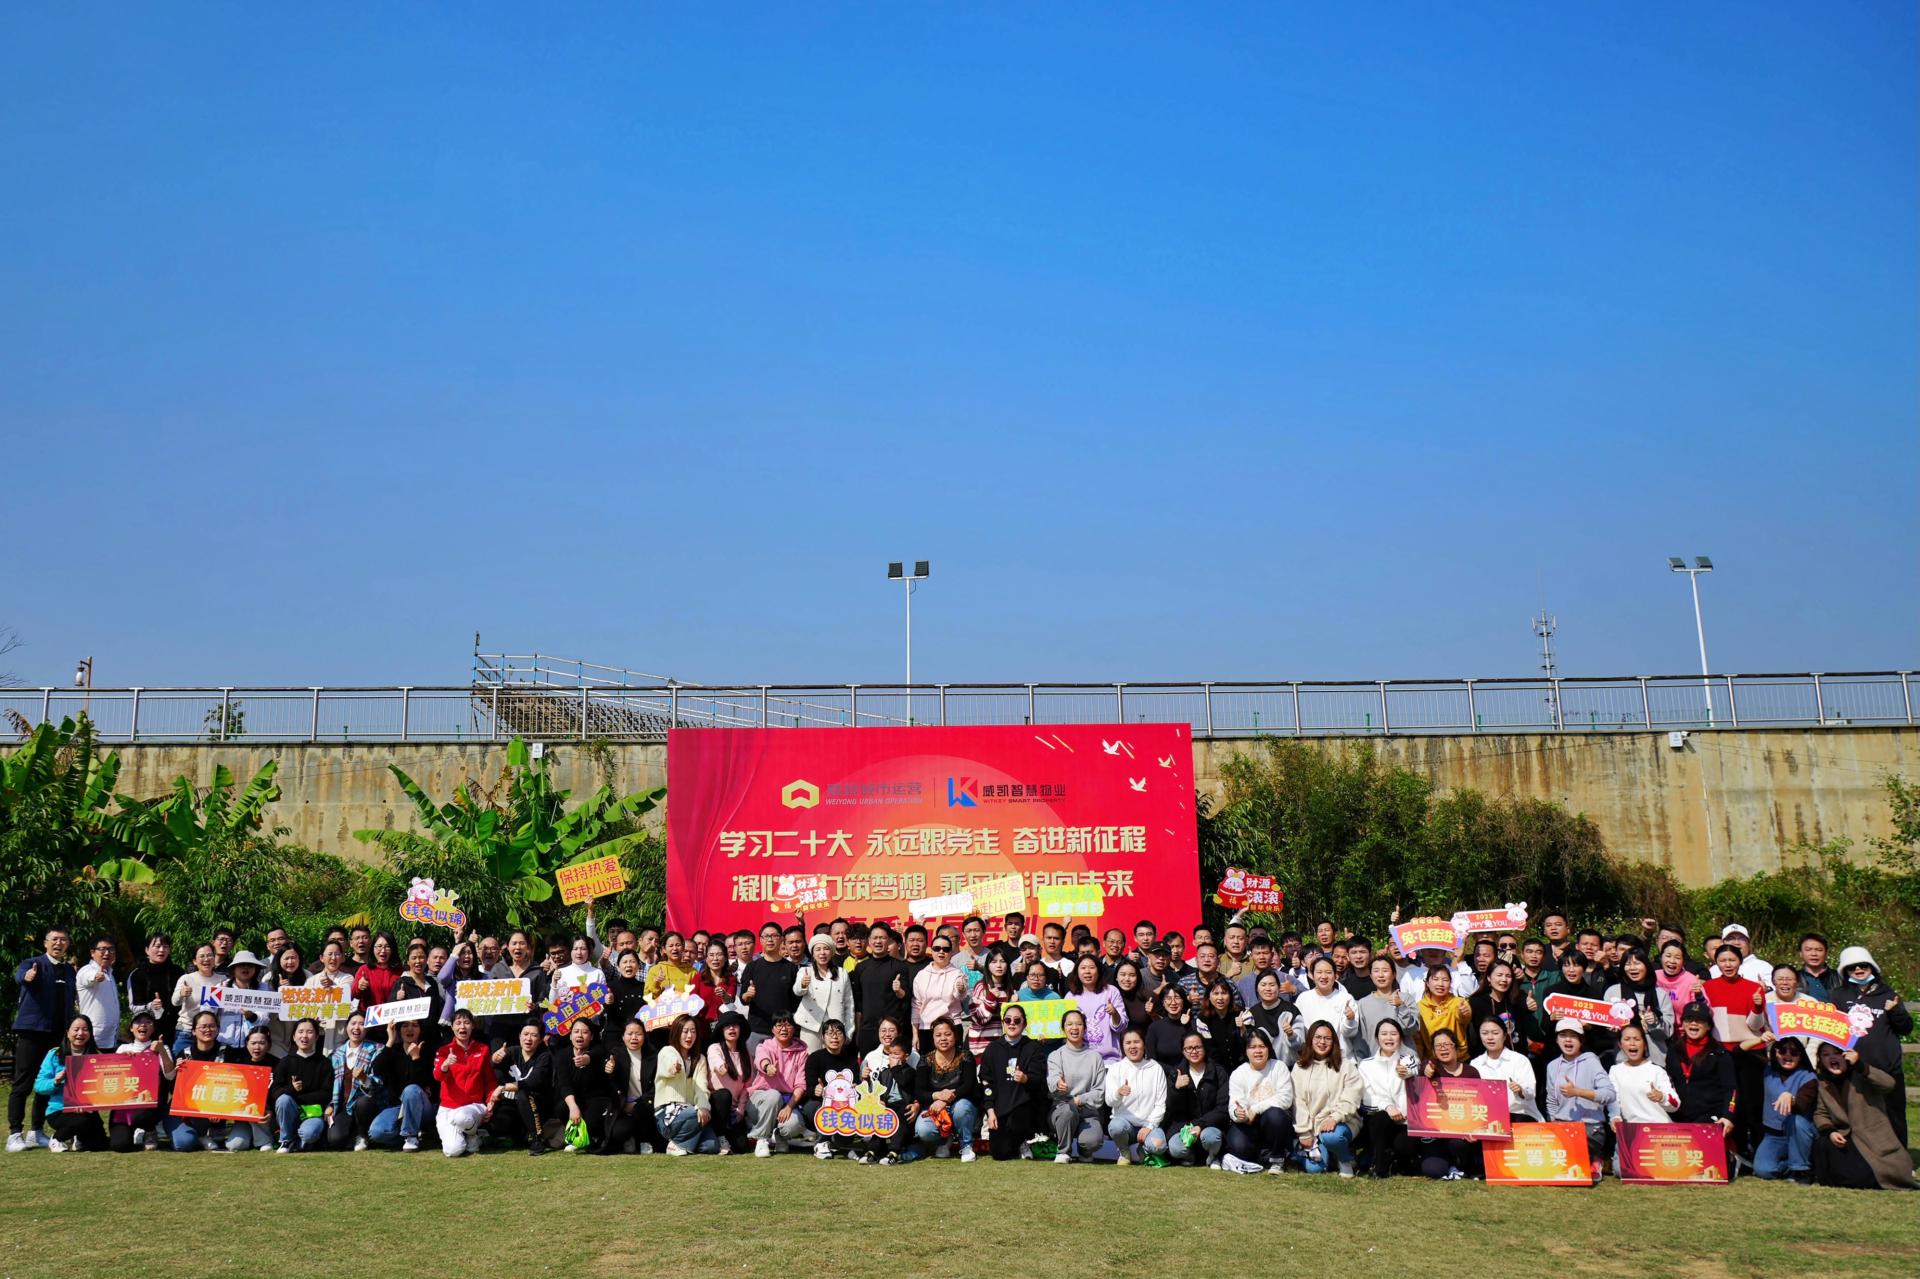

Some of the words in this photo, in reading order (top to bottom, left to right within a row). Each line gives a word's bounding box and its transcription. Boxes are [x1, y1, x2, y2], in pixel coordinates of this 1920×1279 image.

[983, 784, 1066, 797] 威凯智慧物业
[719, 830, 854, 858] 学习二十大
[867, 828, 1000, 855] 永远跟党走
[1012, 825, 1147, 854] 奋进新征程
[560, 858, 617, 885] 保持热爱
[565, 876, 622, 902] 奔赴山海
[796, 877, 818, 890] 财源
[1246, 878, 1271, 889] 财源
[1229, 896, 1237, 905] 福
[1248, 891, 1279, 904] 滚滚
[406, 904, 462, 924] 钱兔似锦
[1401, 928, 1454, 945] 兔飞猛进
[282, 986, 343, 1003] 燃烧激情
[457, 980, 521, 998] 燃烧激情
[1572, 1001, 1594, 1010] 2023
[1779, 1011, 1849, 1039] 兔飞猛进
[82, 1077, 140, 1095] 二等奖
[192, 1084, 249, 1105] 优胜奖
[822, 1111, 893, 1130] 钱兔似锦
[1426, 1102, 1488, 1122] 三等奖
[1503, 1149, 1567, 1167] 三等奖
[1638, 1149, 1704, 1168] 三等奖
